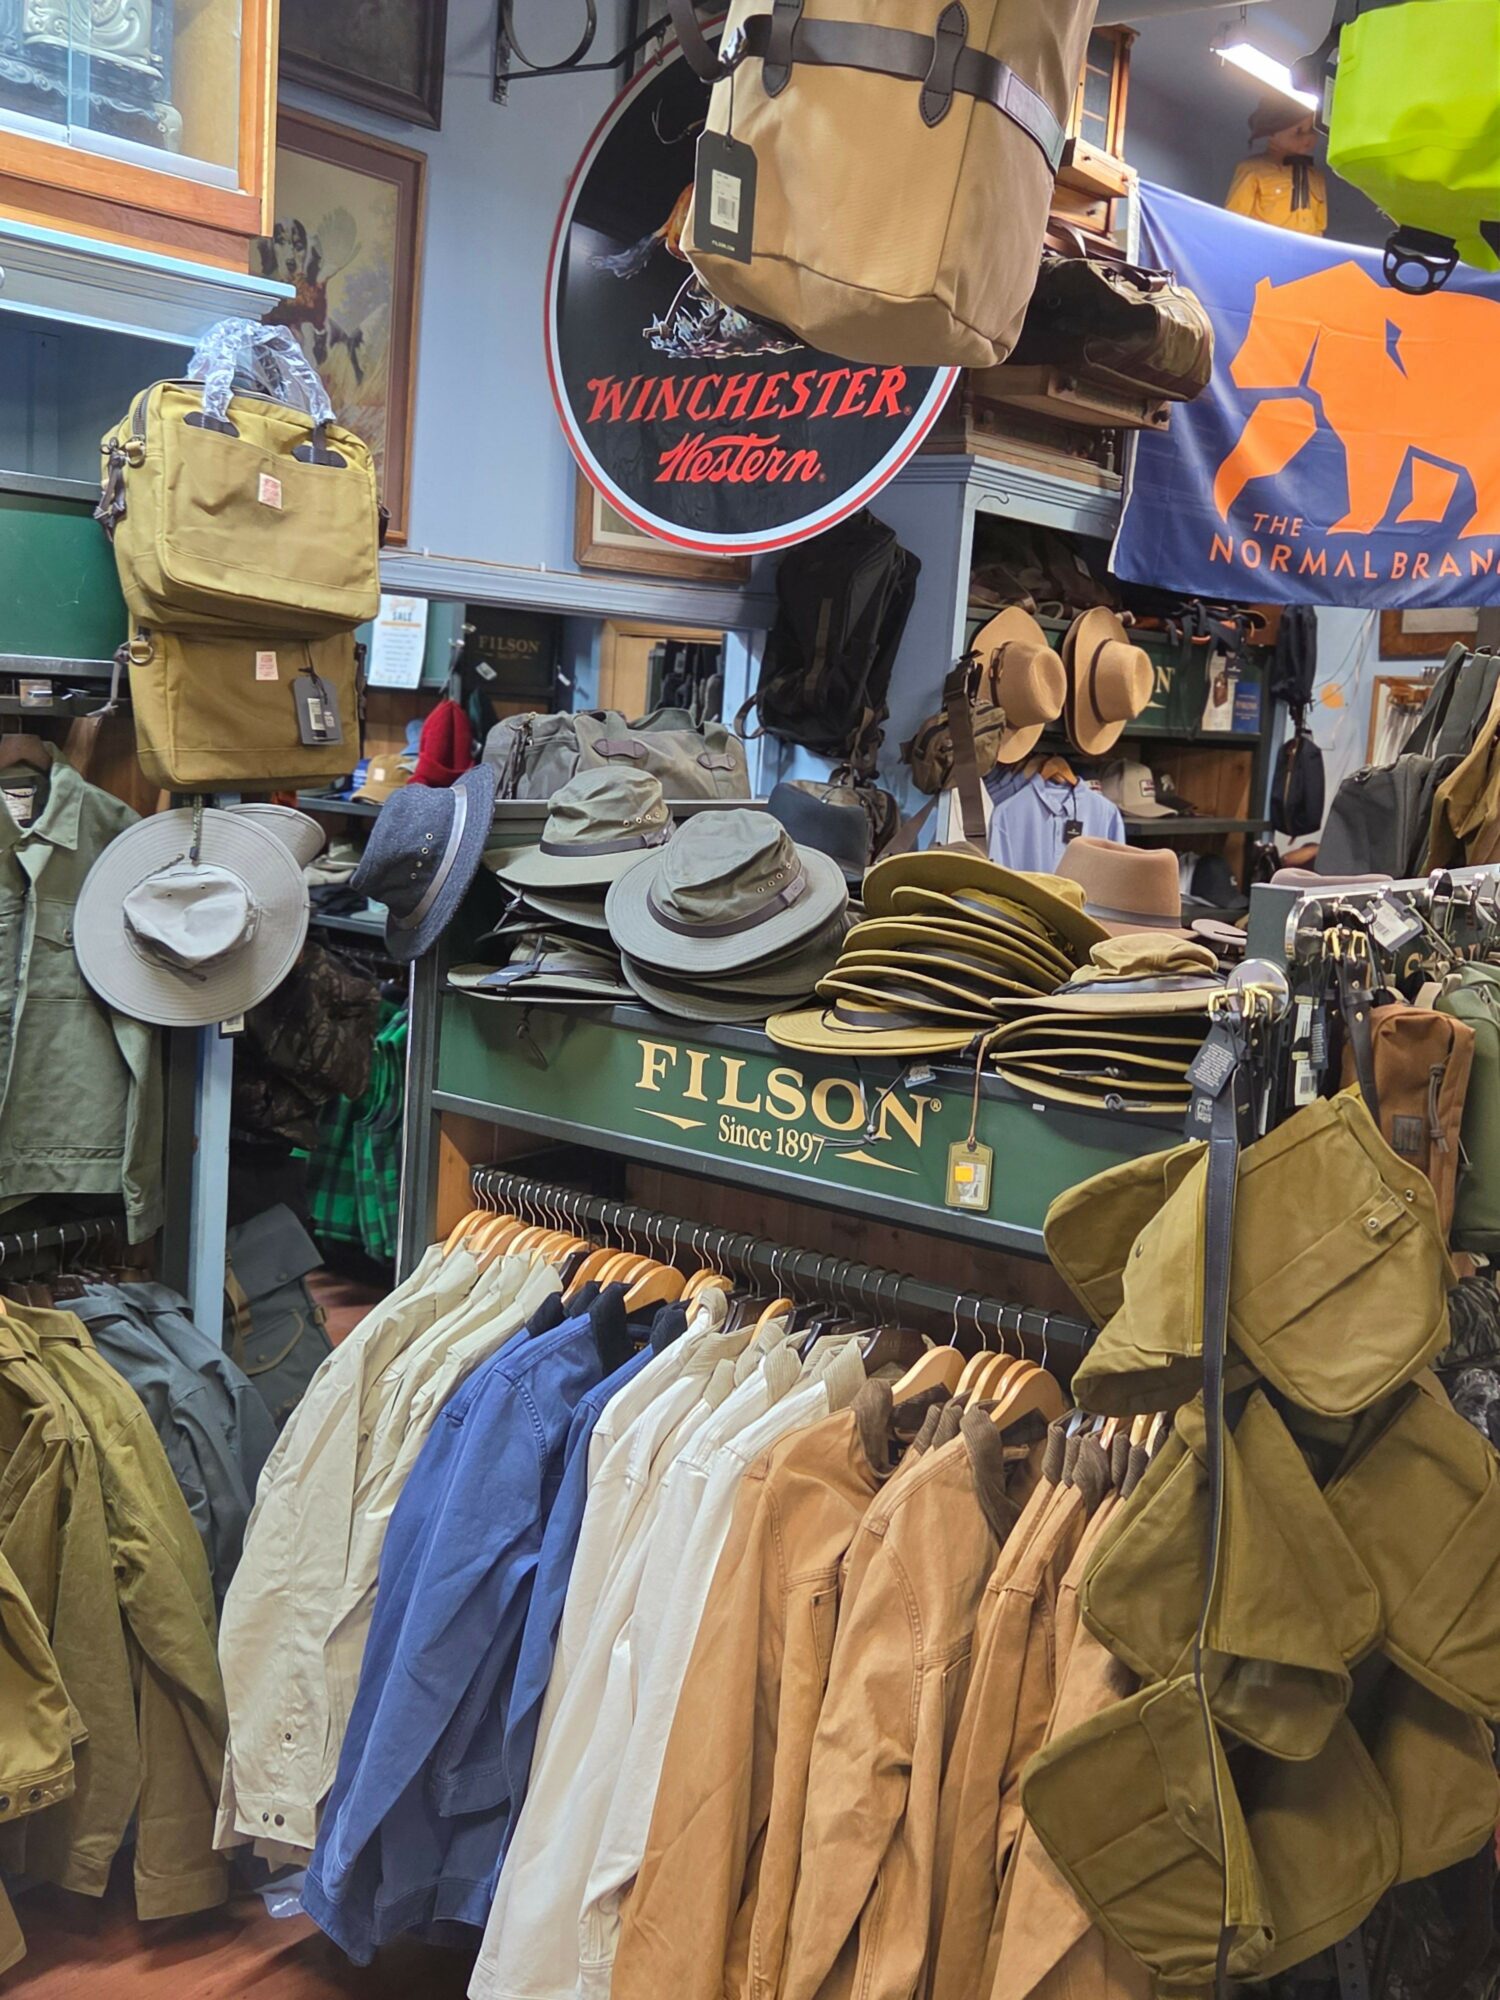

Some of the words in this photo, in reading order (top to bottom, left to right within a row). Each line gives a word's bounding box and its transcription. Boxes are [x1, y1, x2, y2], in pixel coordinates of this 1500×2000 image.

[587, 365, 907, 423] WINCHESTER
[654, 432, 822, 483] Western
[1253, 513, 1304, 537] THE
[1209, 533, 1378, 579] NORMAL
[1391, 549, 1500, 579] BRAN
[479, 635, 541, 653] FILSON
[718, 1114, 772, 1152] Since
[775, 1127, 826, 1165] 1897
